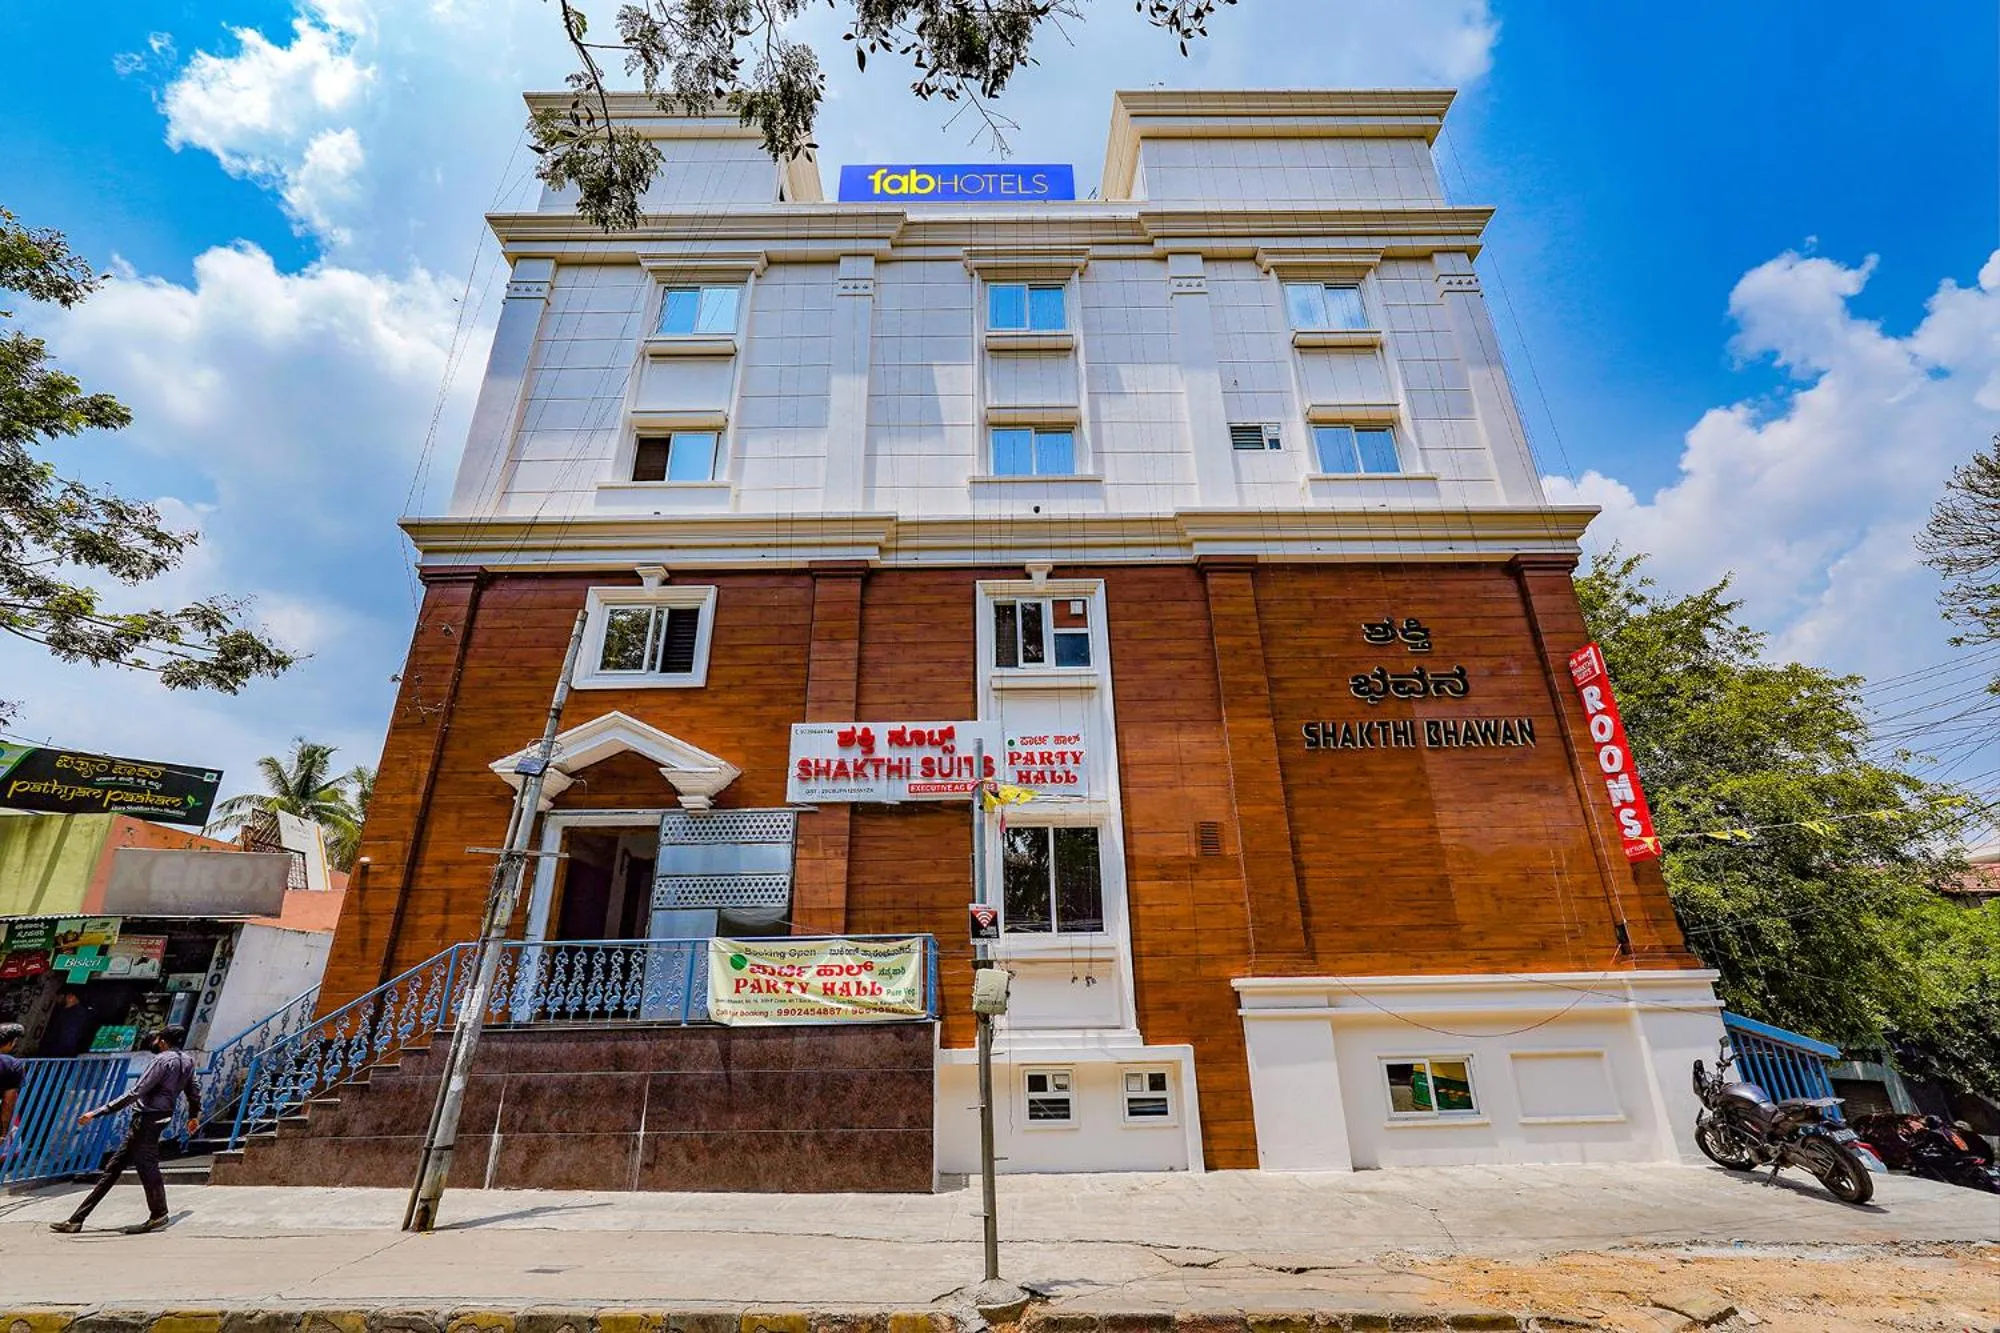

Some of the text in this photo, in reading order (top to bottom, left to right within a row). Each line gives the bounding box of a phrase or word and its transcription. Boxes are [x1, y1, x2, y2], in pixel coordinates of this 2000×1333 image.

[867, 168, 1049, 195] fabHOTELS
[1361, 616, 1433, 653] ಶಕ್ತಿ
[1348, 664, 1471, 704] ಭವನ
[1302, 717, 1536, 750] SHAKTHI BHAWAN
[796, 756, 911, 781] SHAKTHI
[1008, 751, 1084, 766] PARTY
[1581, 685, 1643, 838] ROOMS
[910, 784, 952, 792] EXECUTIVE
[1016, 769, 1078, 785] HALL
[744, 947, 816, 959] Booking Open
[816, 961, 874, 977] ಹಾಲ್
[734, 978, 810, 994] PARTY
[822, 981, 883, 997] HALL
